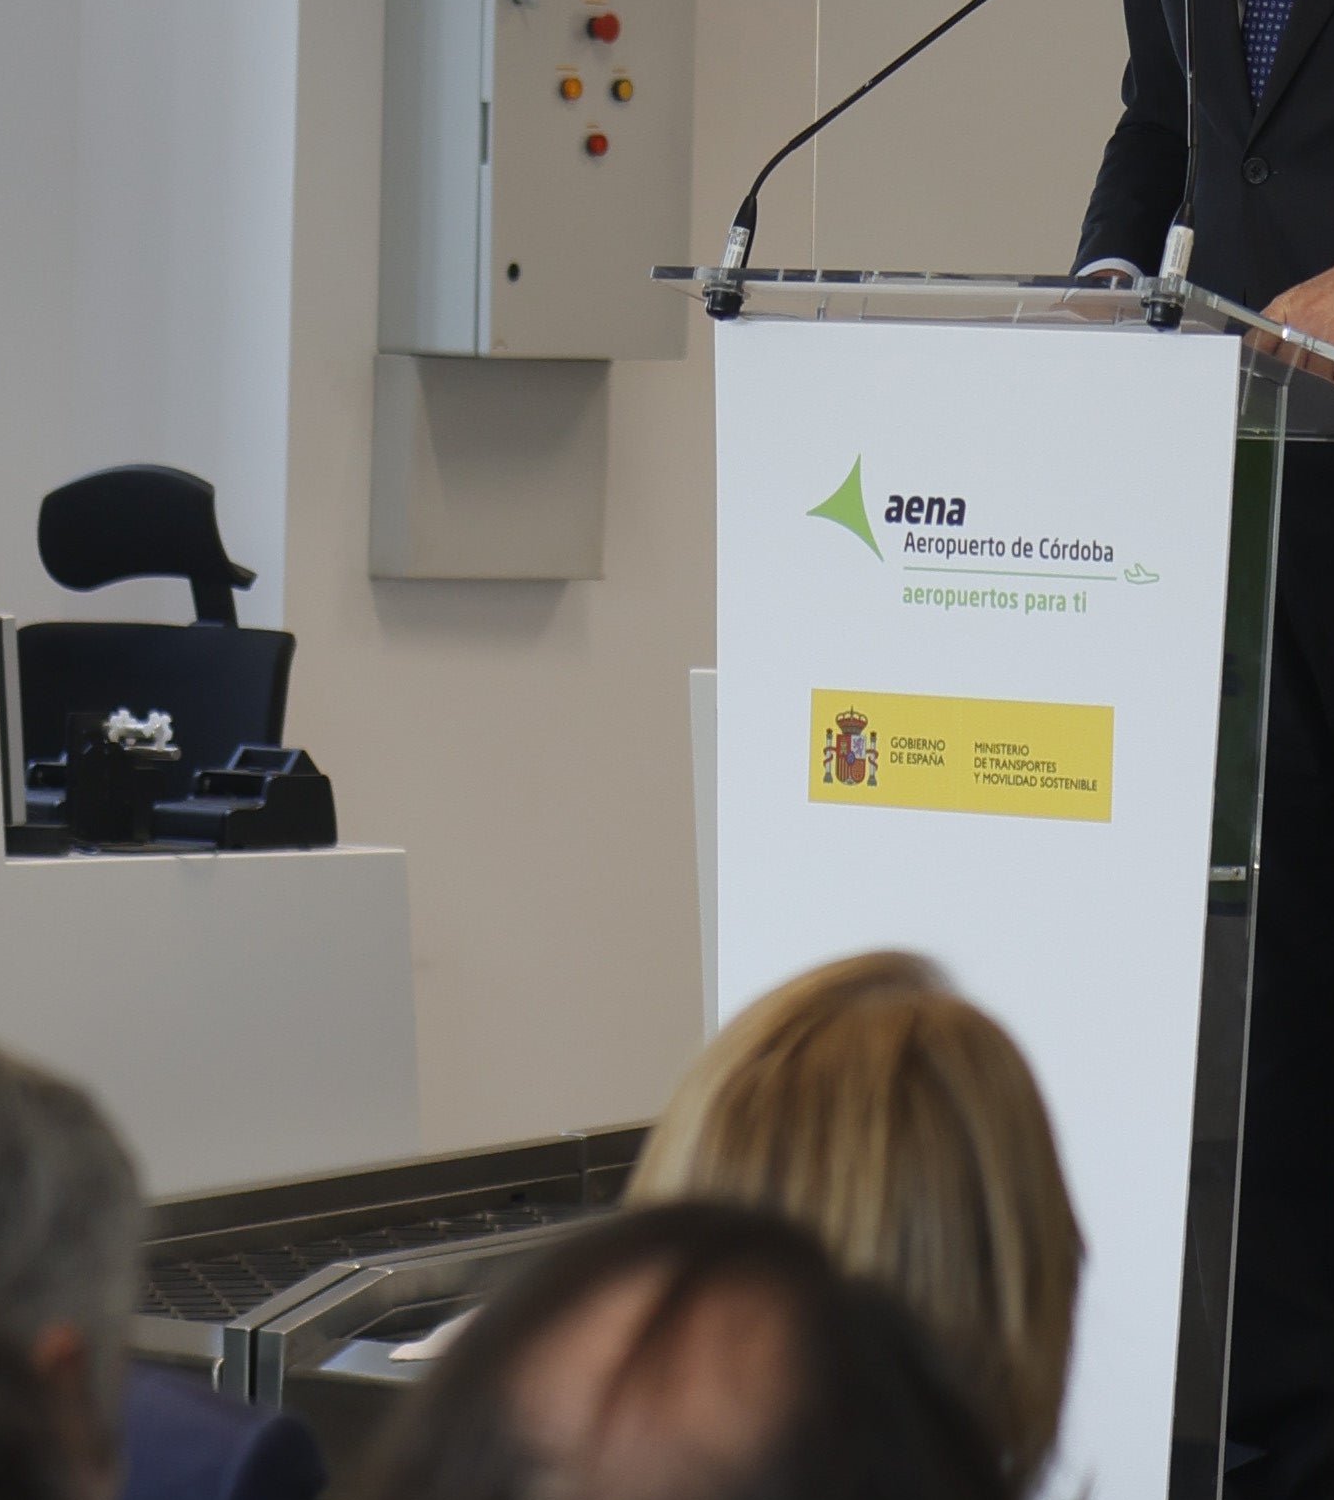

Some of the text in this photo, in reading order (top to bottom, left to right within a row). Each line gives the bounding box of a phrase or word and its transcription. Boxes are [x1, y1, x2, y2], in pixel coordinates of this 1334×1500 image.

[884, 494, 967, 527] aena
[903, 531, 1115, 563] Aeropuerto de Córdoba
[902, 585, 1088, 616] aeropuertos para ti
[890, 736, 946, 752] GOBIERNO
[973, 741, 1030, 757] MINISTERIO
[889, 752, 945, 767] DE ESPAÑA
[973, 757, 1057, 774] DE TRANSPORTES
[973, 772, 1098, 793] Y MOVILIDAD SOSTENIBLE
